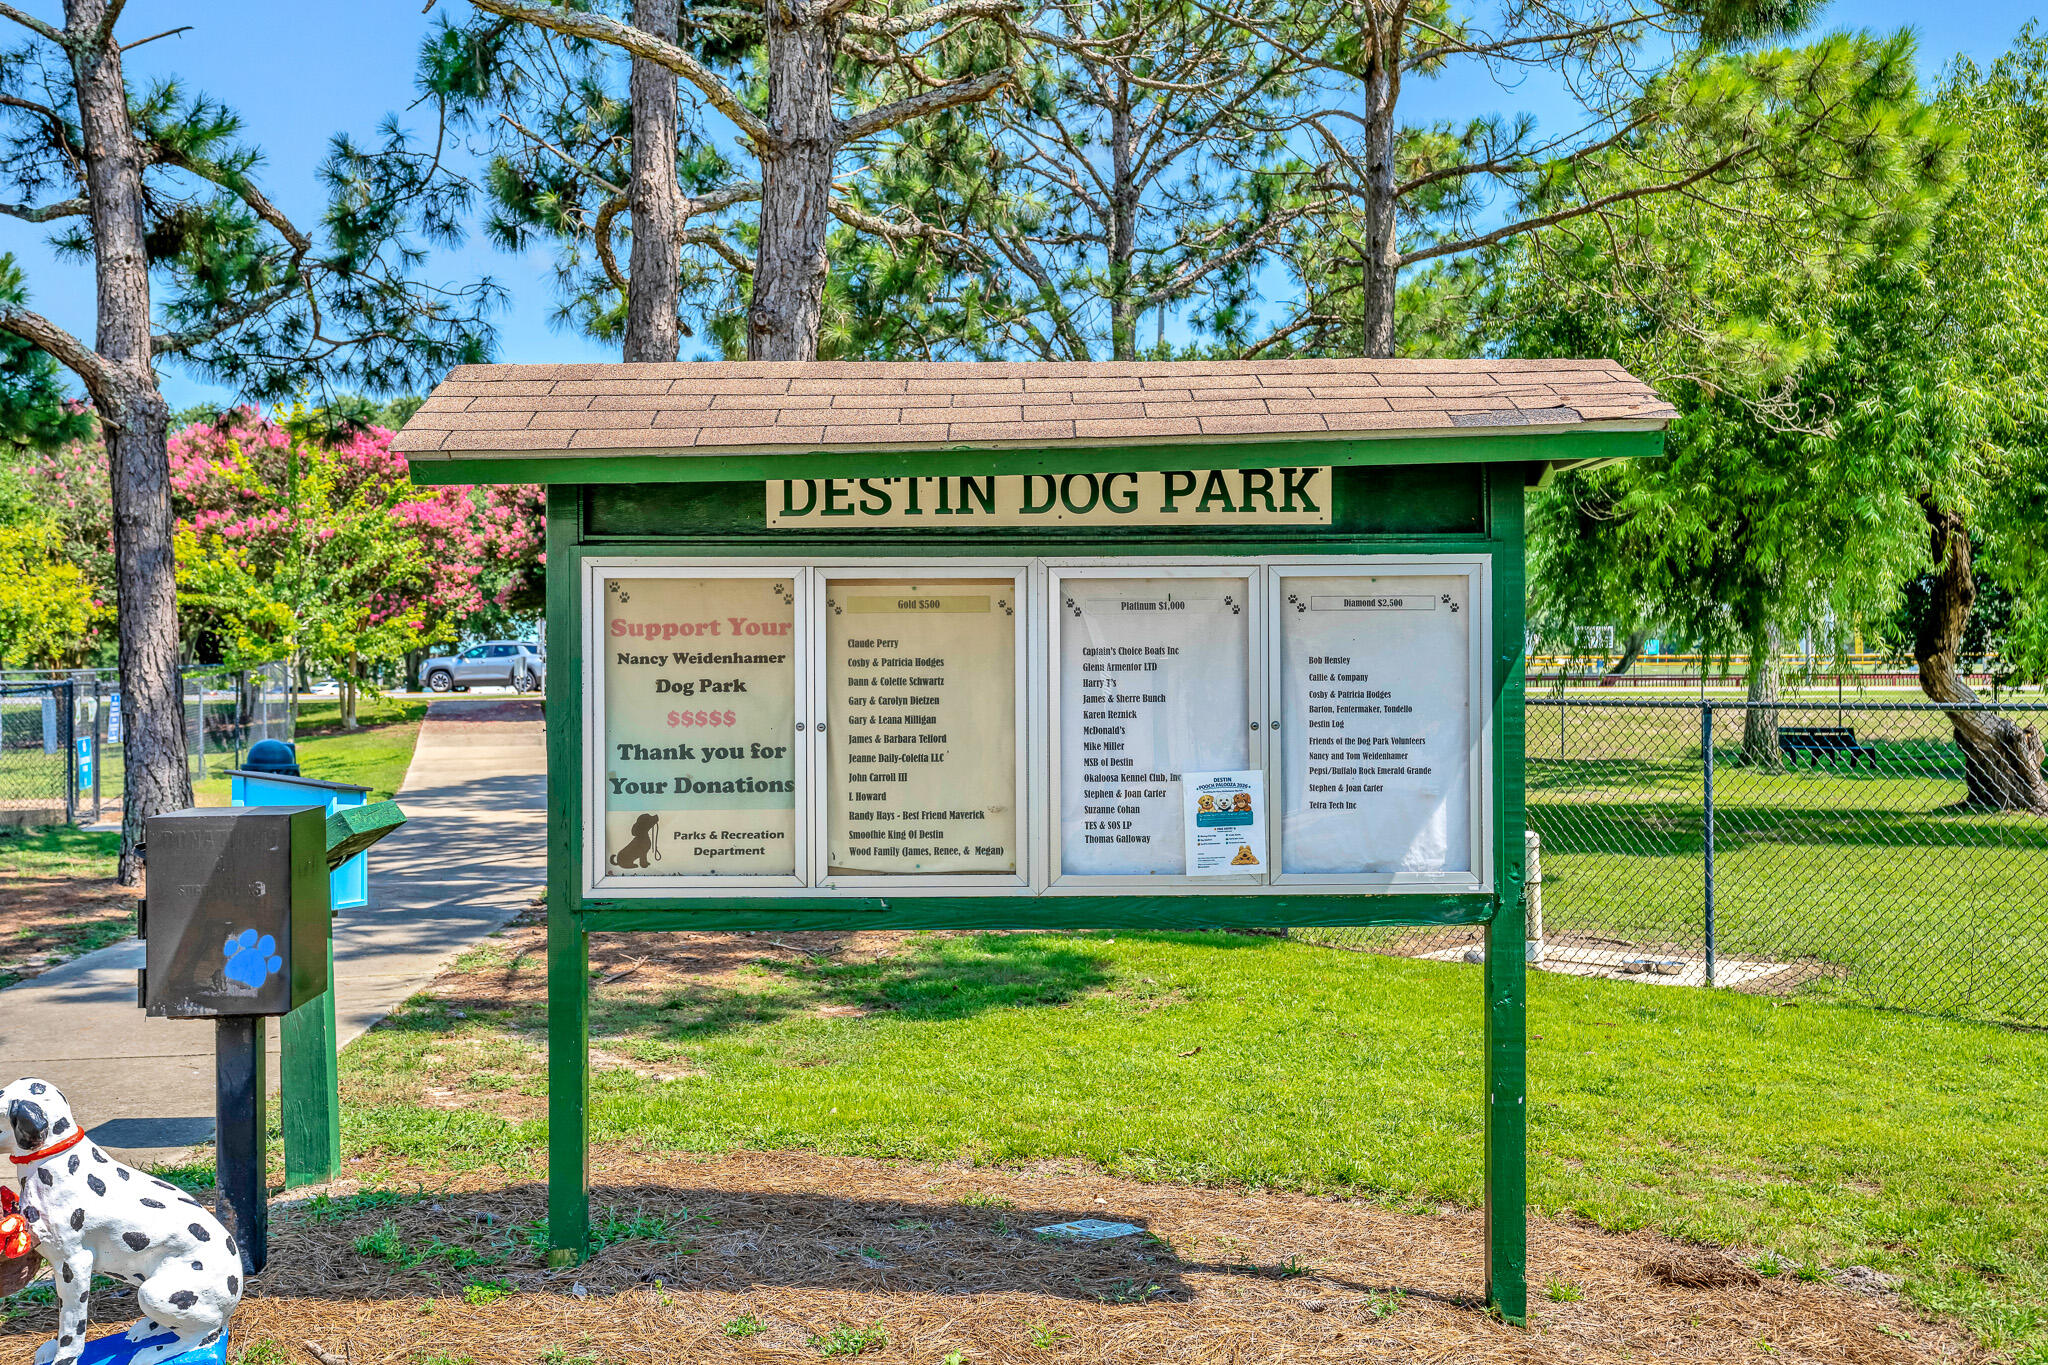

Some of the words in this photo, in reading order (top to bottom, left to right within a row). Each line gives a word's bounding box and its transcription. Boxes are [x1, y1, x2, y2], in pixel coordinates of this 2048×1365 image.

[779, 477, 995, 517] DESTIN
[1019, 472, 1139, 514] DOG
[1159, 468, 1320, 513] PARK
[897, 600, 916, 609] Gold
[919, 600, 940, 609] $500
[1121, 601, 1156, 610] Platinum
[1158, 601, 1185, 611] $1,000
[1343, 599, 1375, 607] Diamond
[1377, 599, 1403, 608] $2,500
[610, 619, 721, 640] Support
[730, 618, 792, 636] Your
[848, 639, 874, 648] Claude
[876, 639, 898, 648] Perry
[1083, 647, 1116, 656] Captain's
[1118, 647, 1142, 655] Choice
[1144, 647, 1165, 655] Boats
[1167, 647, 1179, 655] Inc
[617, 653, 666, 666] Nancy
[673, 652, 785, 664] Weidenhamer
[848, 658, 869, 667] Cosby
[872, 658, 879, 666] &
[881, 658, 913, 666] Patricia
[915, 658, 944, 667] Hodges
[1324, 657, 1350, 665] Hensley
[1083, 663, 1104, 671] Glenn
[1106, 663, 1142, 671] Armentor
[1144, 663, 1157, 671] LTD
[848, 677, 868, 686] Dann
[871, 677, 877, 686] &
[880, 677, 907, 686] Colette
[909, 677, 944, 686] Schwartz
[1309, 673, 1327, 681] Callie
[1330, 673, 1335, 681] &
[1337, 674, 1368, 682] Company
[655, 679, 694, 695] Dog
[700, 679, 746, 692] Park
[1083, 679, 1104, 688] Harry
[1083, 695, 1105, 704] James
[1108, 694, 1114, 702] &
[1116, 694, 1140, 702] Sherre
[1142, 694, 1166, 702] Bunch
[1309, 691, 1328, 699] Cosby
[1330, 690, 1335, 698] &
[1337, 690, 1364, 698] Patricia
[1366, 690, 1391, 699] Hodges
[848, 696, 867, 706] Gary
[869, 696, 875, 704] &
[878, 696, 908, 705] Carolyn
[910, 696, 939, 704] Dietzen
[1309, 705, 1334, 714] Barton,
[667, 710, 736, 728] $$$$$
[1083, 710, 1105, 719] Karen
[1108, 710, 1137, 719] Reznick
[848, 716, 867, 725] Gary
[870, 715, 876, 724] &
[878, 715, 902, 724] Leana
[904, 715, 936, 725] Milligan
[1309, 720, 1330, 728] Destin
[1332, 720, 1344, 728] Log
[1083, 726, 1125, 734] McDonald's
[848, 735, 872, 744] James
[875, 734, 881, 743] &
[883, 734, 916, 743] Barbara
[919, 734, 946, 743] Telford
[1309, 737, 1334, 745] Friends
[1336, 737, 1343, 745] of
[1344, 737, 1355, 745] the
[1357, 737, 1370, 746] Dog
[1372, 737, 1389, 745] Park
[1390, 737, 1425, 745] Volunteers
[1083, 742, 1101, 751] Mike
[1104, 742, 1124, 751] Miller
[617, 744, 694, 761] Thank
[701, 747, 746, 763] you
[750, 743, 786, 759] for
[1309, 752, 1329, 761] Nancy
[1331, 752, 1344, 760] and
[1346, 752, 1360, 760] Tom
[1362, 752, 1408, 760] Weidenhamer
[848, 754, 876, 763] Jeanne
[878, 754, 928, 763] Daily-Coletta
[931, 754, 944, 762] LLC
[1083, 758, 1098, 766] MSB
[1101, 758, 1108, 766] of
[1110, 758, 1133, 766] Destin
[1358, 767, 1375, 775] Rock
[1377, 767, 1405, 775] Emerald
[1407, 767, 1431, 775] Grande
[848, 773, 867, 783] John
[869, 773, 895, 782] Carroll
[898, 773, 907, 782] III
[1084, 773, 1118, 782] Okaloosa
[1121, 773, 1146, 782] Kennel
[1149, 774, 1167, 783] Club,
[609, 778, 667, 795] Your
[674, 776, 794, 793] Donations
[1309, 784, 1336, 792] Stephen
[1338, 784, 1344, 792] &
[1345, 784, 1361, 792] Joan
[1363, 784, 1383, 792] Carter
[855, 792, 886, 801] Howard
[1084, 790, 1113, 799] Stephen
[1116, 789, 1122, 797] &
[1124, 789, 1141, 798] Joan
[1143, 789, 1166, 797] Carter
[1084, 805, 1115, 814] Suzanne
[1117, 805, 1140, 814] Cohan
[1309, 801, 1327, 809] Tetra
[1329, 801, 1344, 809] Tech
[1346, 801, 1356, 809] Inc
[849, 812, 874, 821] Randy
[902, 811, 919, 819] Best
[921, 811, 946, 819] Friend
[949, 811, 984, 819] Maverick
[1085, 821, 1097, 829] TES
[1100, 821, 1105, 829] &
[1107, 821, 1120, 829] SOS
[1123, 821, 1132, 829] LP
[673, 830, 705, 840] Parks
[709, 830, 717, 840] &
[721, 830, 785, 840] Recreation
[849, 830, 885, 839] Smoothie
[887, 830, 906, 840] King
[908, 830, 917, 839] Of
[919, 830, 943, 839] Destin
[1085, 834, 1114, 844] Thomas
[1116, 834, 1150, 844] Galloway
[693, 846, 765, 857] Department
[849, 847, 871, 856] Wood
[873, 847, 899, 856] Family
[902, 847, 931, 856] (James,
[934, 847, 960, 856] Renee,
[963, 846, 969, 855] &
[975, 847, 1004, 856] Megan)
